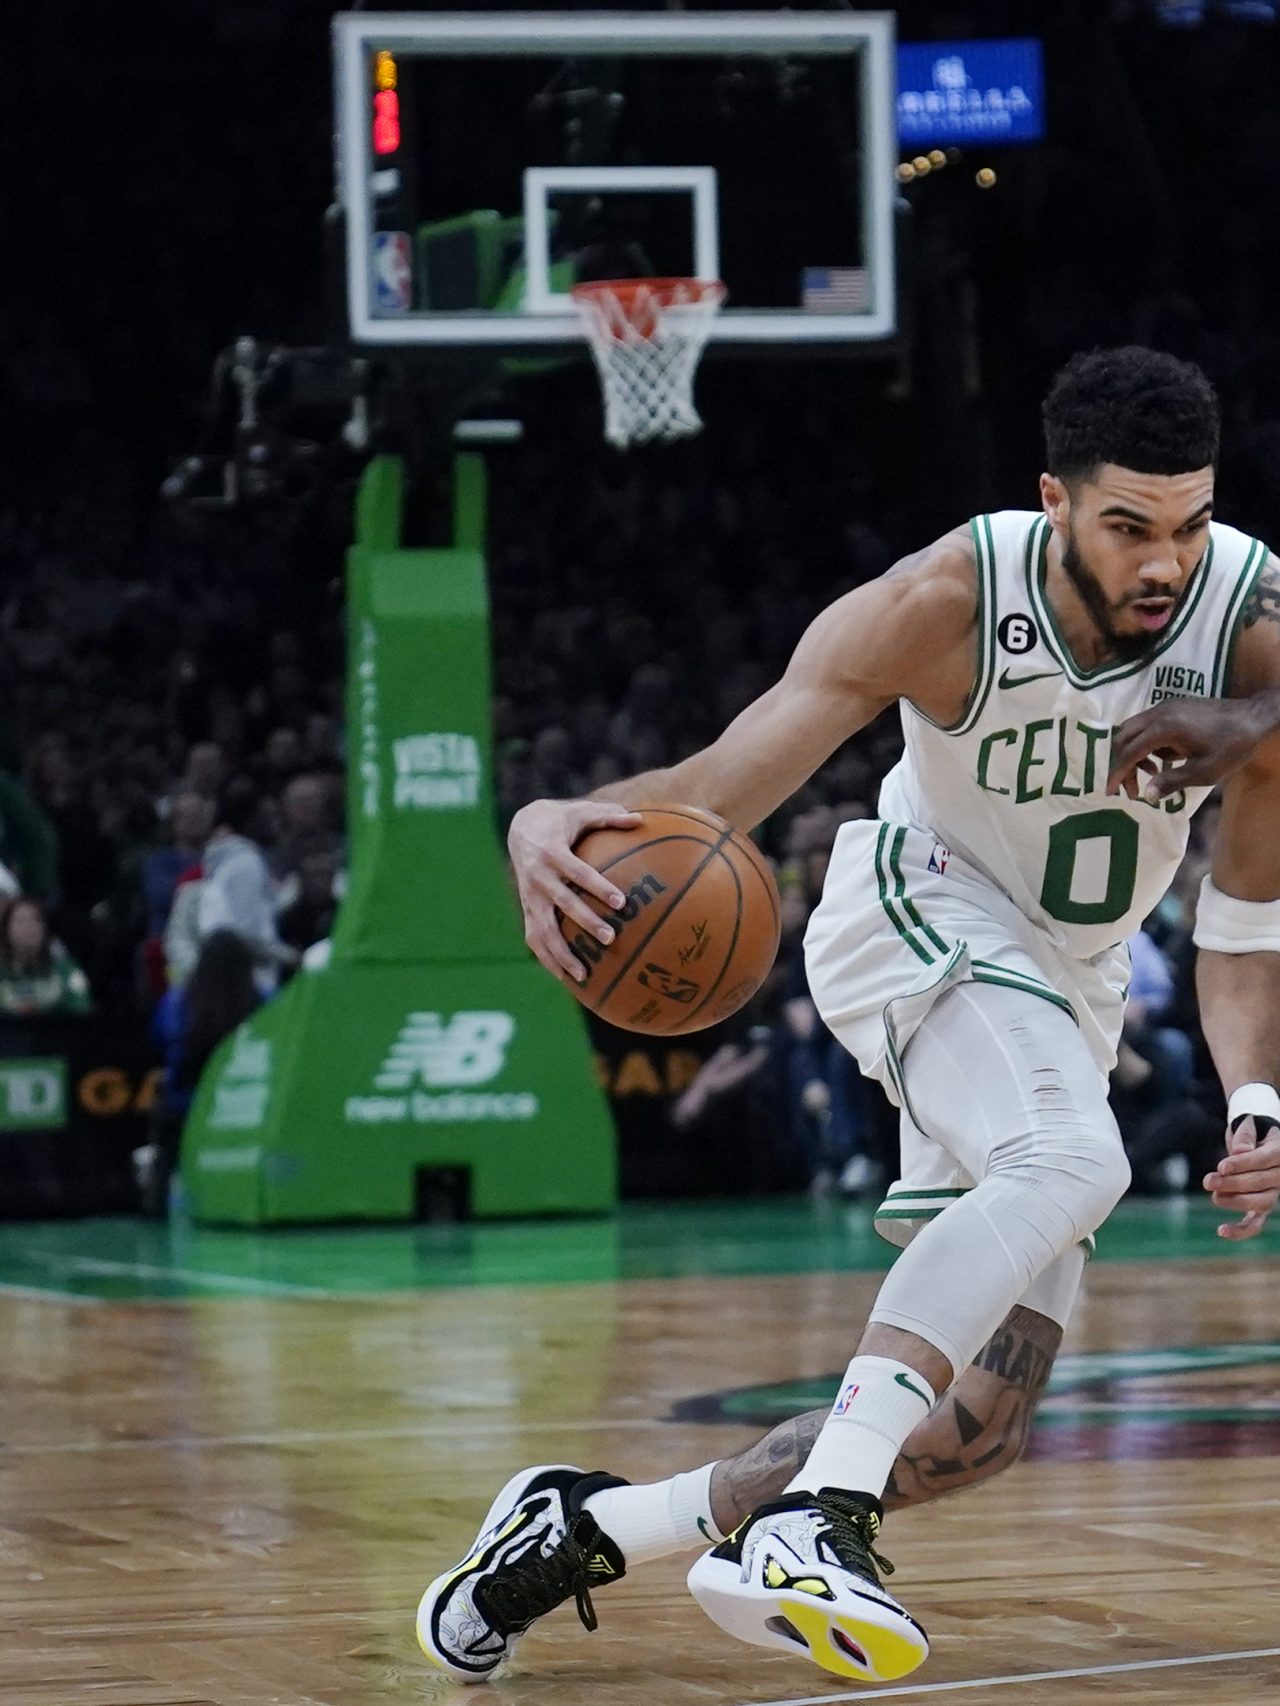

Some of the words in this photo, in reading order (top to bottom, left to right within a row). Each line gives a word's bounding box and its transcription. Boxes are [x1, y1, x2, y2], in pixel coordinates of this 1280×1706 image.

[1006, 618, 1030, 650] 6
[1154, 666, 1205, 696] VISTA
[977, 716, 1186, 814] CELTS
[1040, 809, 1140, 925] 0
